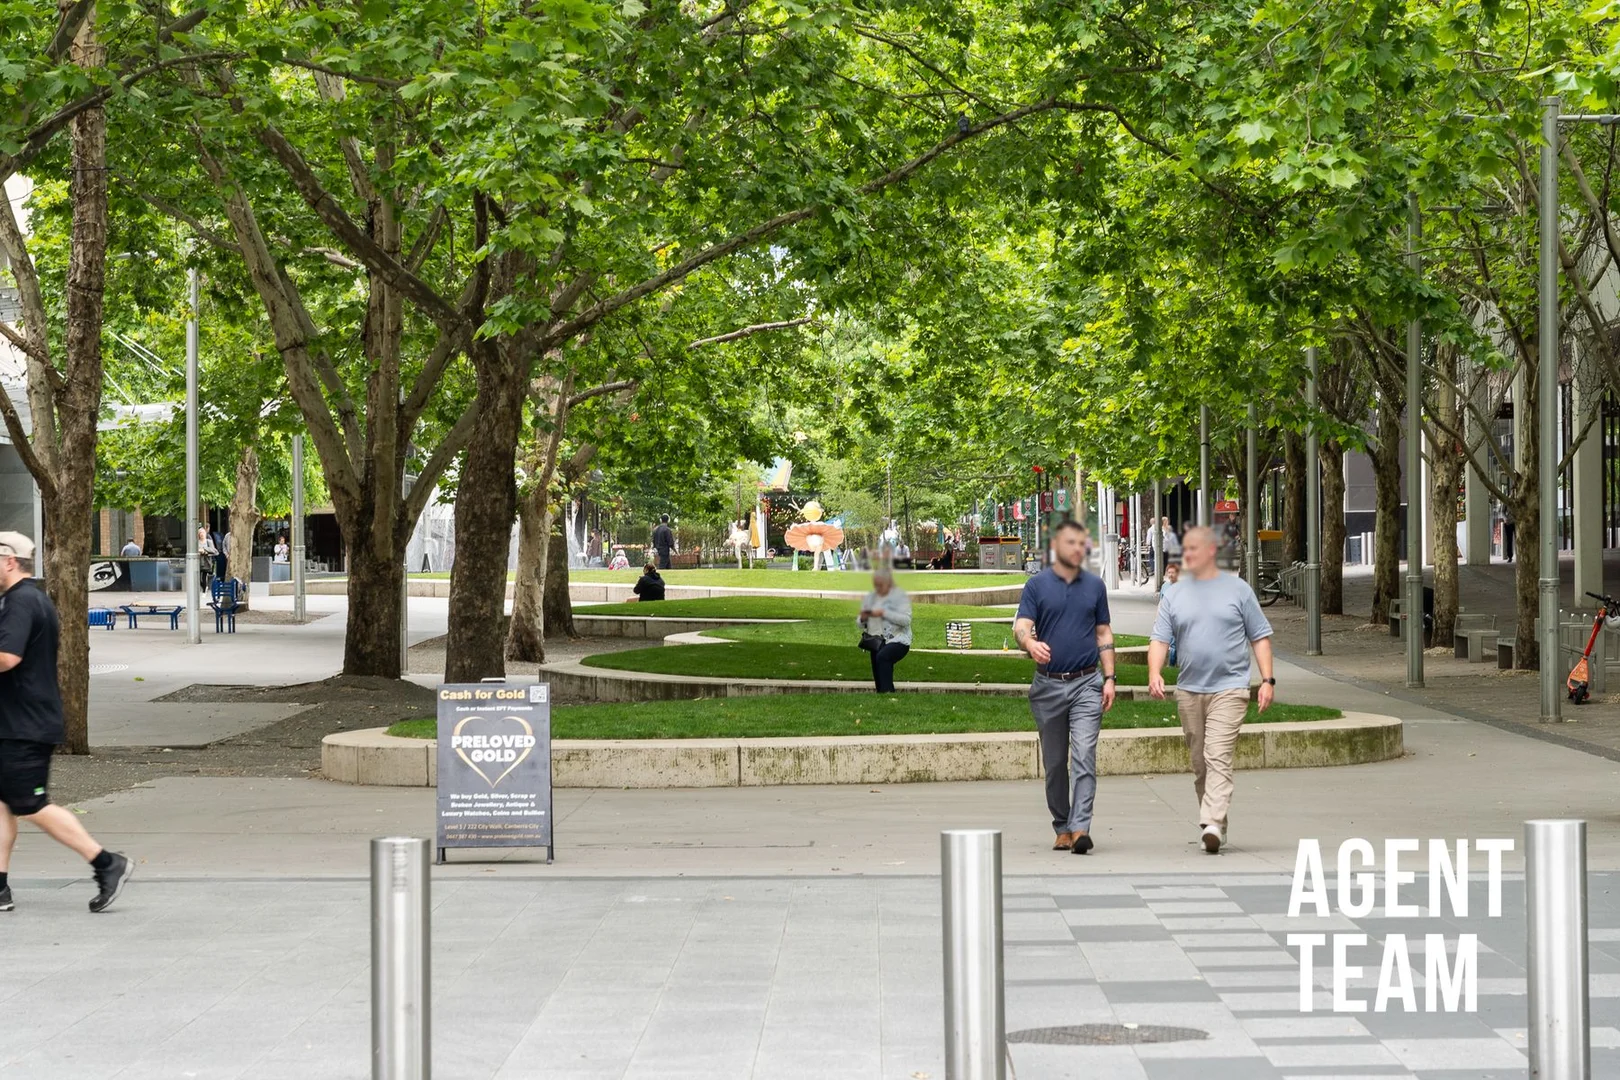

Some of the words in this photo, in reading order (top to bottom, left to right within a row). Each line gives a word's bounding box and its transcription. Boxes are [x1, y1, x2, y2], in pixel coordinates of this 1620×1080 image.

[440, 690, 472, 700] Cash
[475, 689, 493, 700] for
[496, 689, 526, 699] Gold
[451, 735, 536, 748] PRELOVED
[471, 749, 517, 762] GOLD
